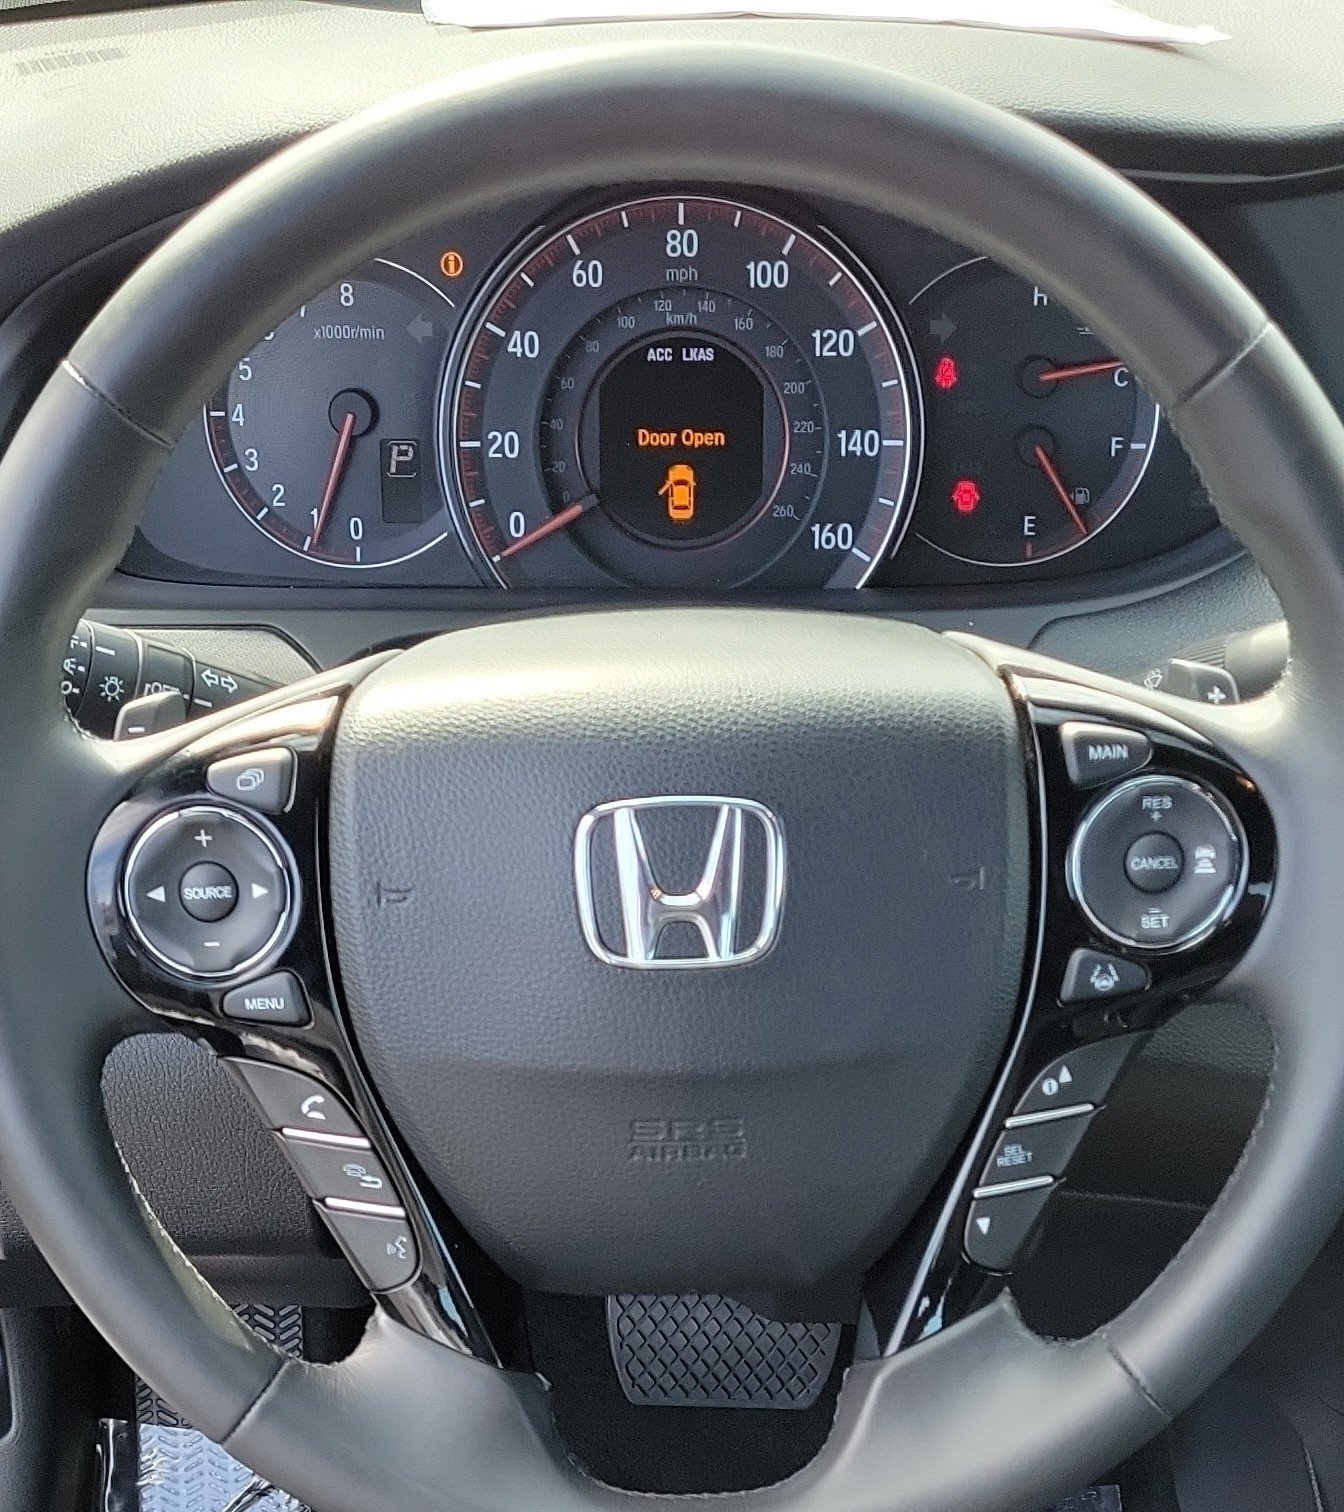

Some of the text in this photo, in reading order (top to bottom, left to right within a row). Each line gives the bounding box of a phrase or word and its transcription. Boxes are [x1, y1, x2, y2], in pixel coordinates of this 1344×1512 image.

[666, 229, 698, 258] 80
[572, 259, 603, 288] 60
[666, 267, 698, 285] mph
[746, 260, 789, 289] 100
[340, 283, 354, 306] 8
[653, 299, 672, 312] 120
[697, 301, 716, 314] 140
[666, 312, 697, 325] km/h
[734, 318, 753, 331] 160
[313, 325, 386, 341] x1000r/min
[811, 329, 855, 358] 120
[507, 330, 540, 358] 40
[647, 347, 714, 362] ACC LKAS
[239, 358, 252, 381] 5
[1113, 367, 1129, 388] C
[783, 382, 805, 395] 200
[231, 403, 245, 426] 4
[793, 421, 815, 434] 220
[487, 431, 520, 459] 20
[638, 429, 725, 448] Door Open
[837, 429, 880, 457] 140
[1111, 436, 1124, 457] F
[245, 448, 259, 471] 3
[389, 444, 414, 474] P
[790, 463, 811, 475] 240
[272, 484, 286, 507] 2
[309, 508, 319, 530] 1
[773, 504, 794, 518] 260
[349, 517, 363, 540] 0
[510, 511, 525, 538] 0
[1023, 515, 1036, 536] E
[810, 523, 853, 551] 160
[1088, 744, 1130, 761] MAIN
[1142, 796, 1173, 810] RES
[1130, 857, 1178, 871] CANCEL
[183, 886, 233, 901] SOURCE
[1141, 915, 1170, 929] SET
[244, 997, 285, 1011] MENU
